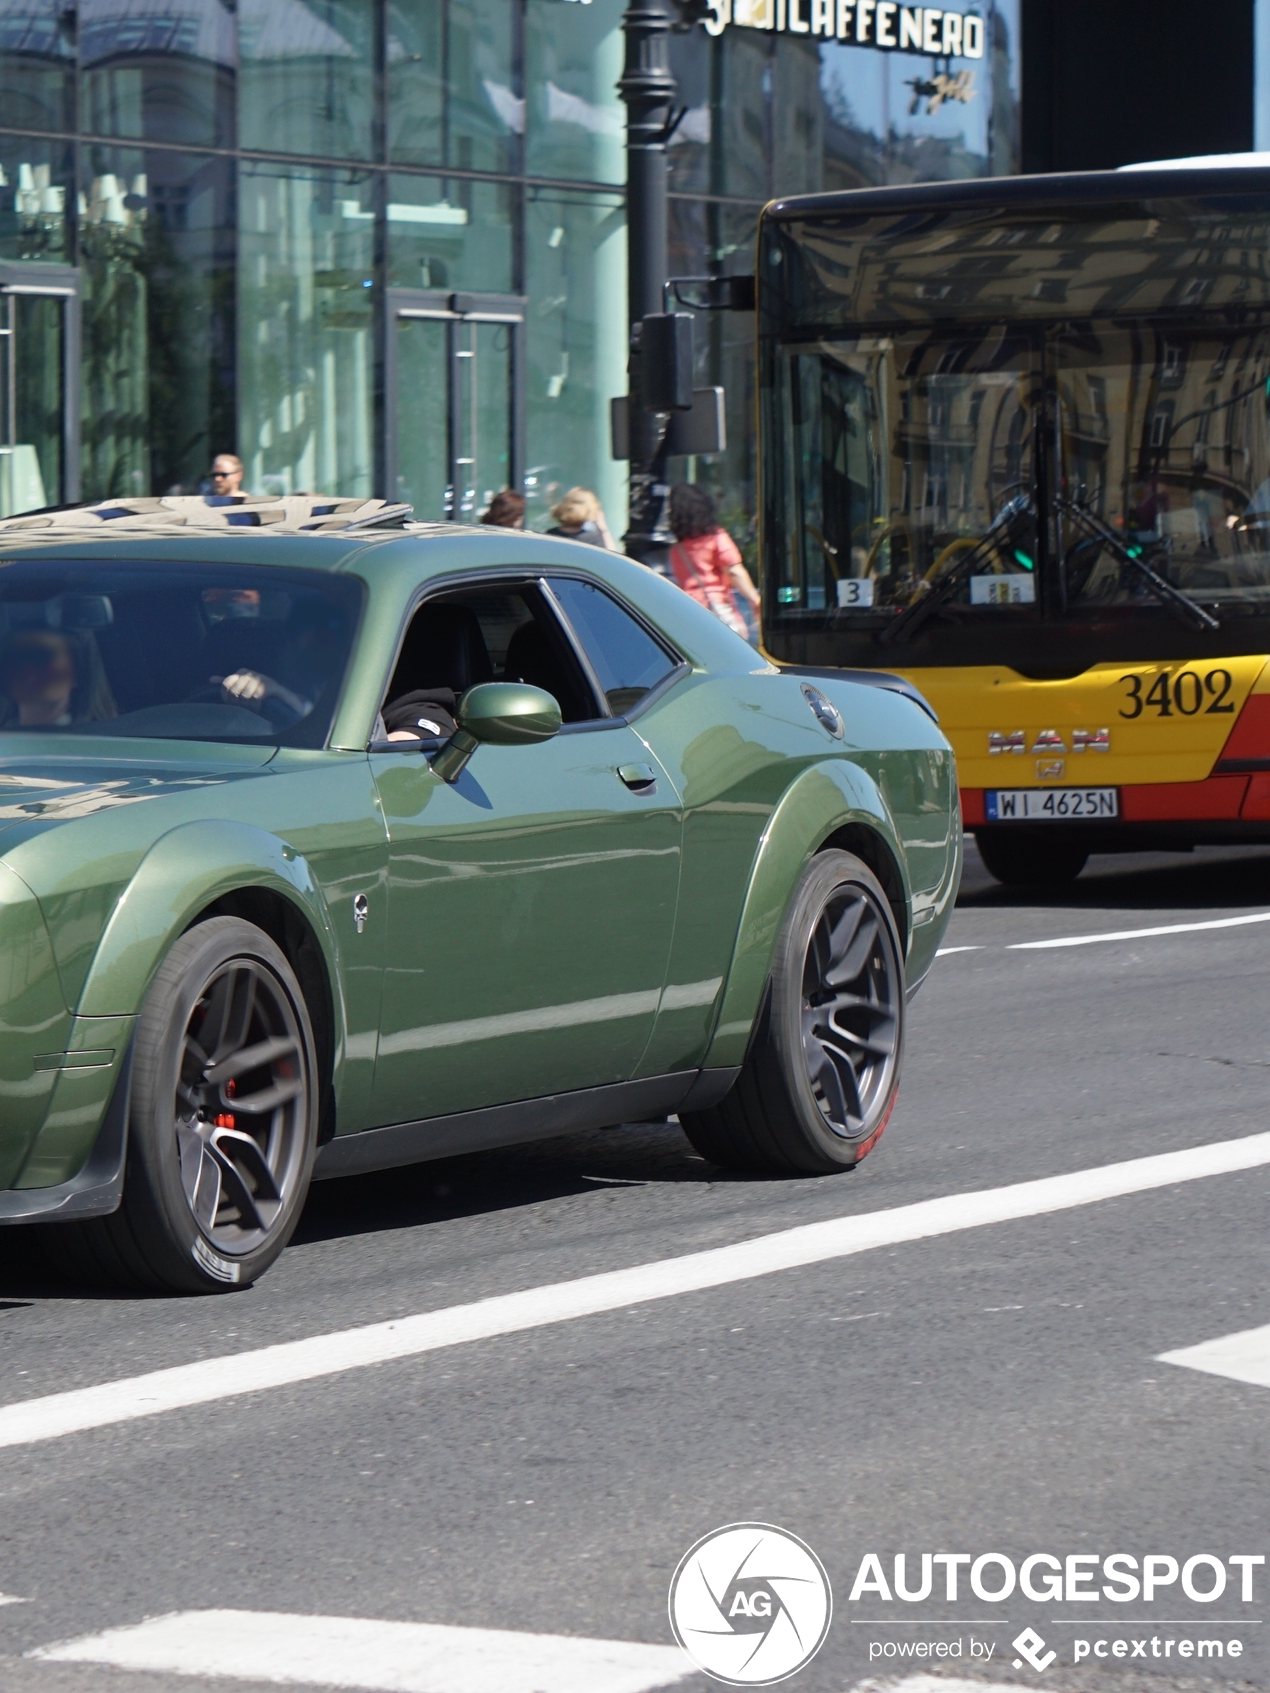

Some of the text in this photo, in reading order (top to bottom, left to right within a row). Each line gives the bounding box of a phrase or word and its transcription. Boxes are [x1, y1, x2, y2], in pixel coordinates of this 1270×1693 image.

[847, 582, 860, 603] 3
[1118, 669, 1235, 719] 3402
[987, 728, 1110, 755] MAN
[1042, 791, 1115, 816] 4625N
